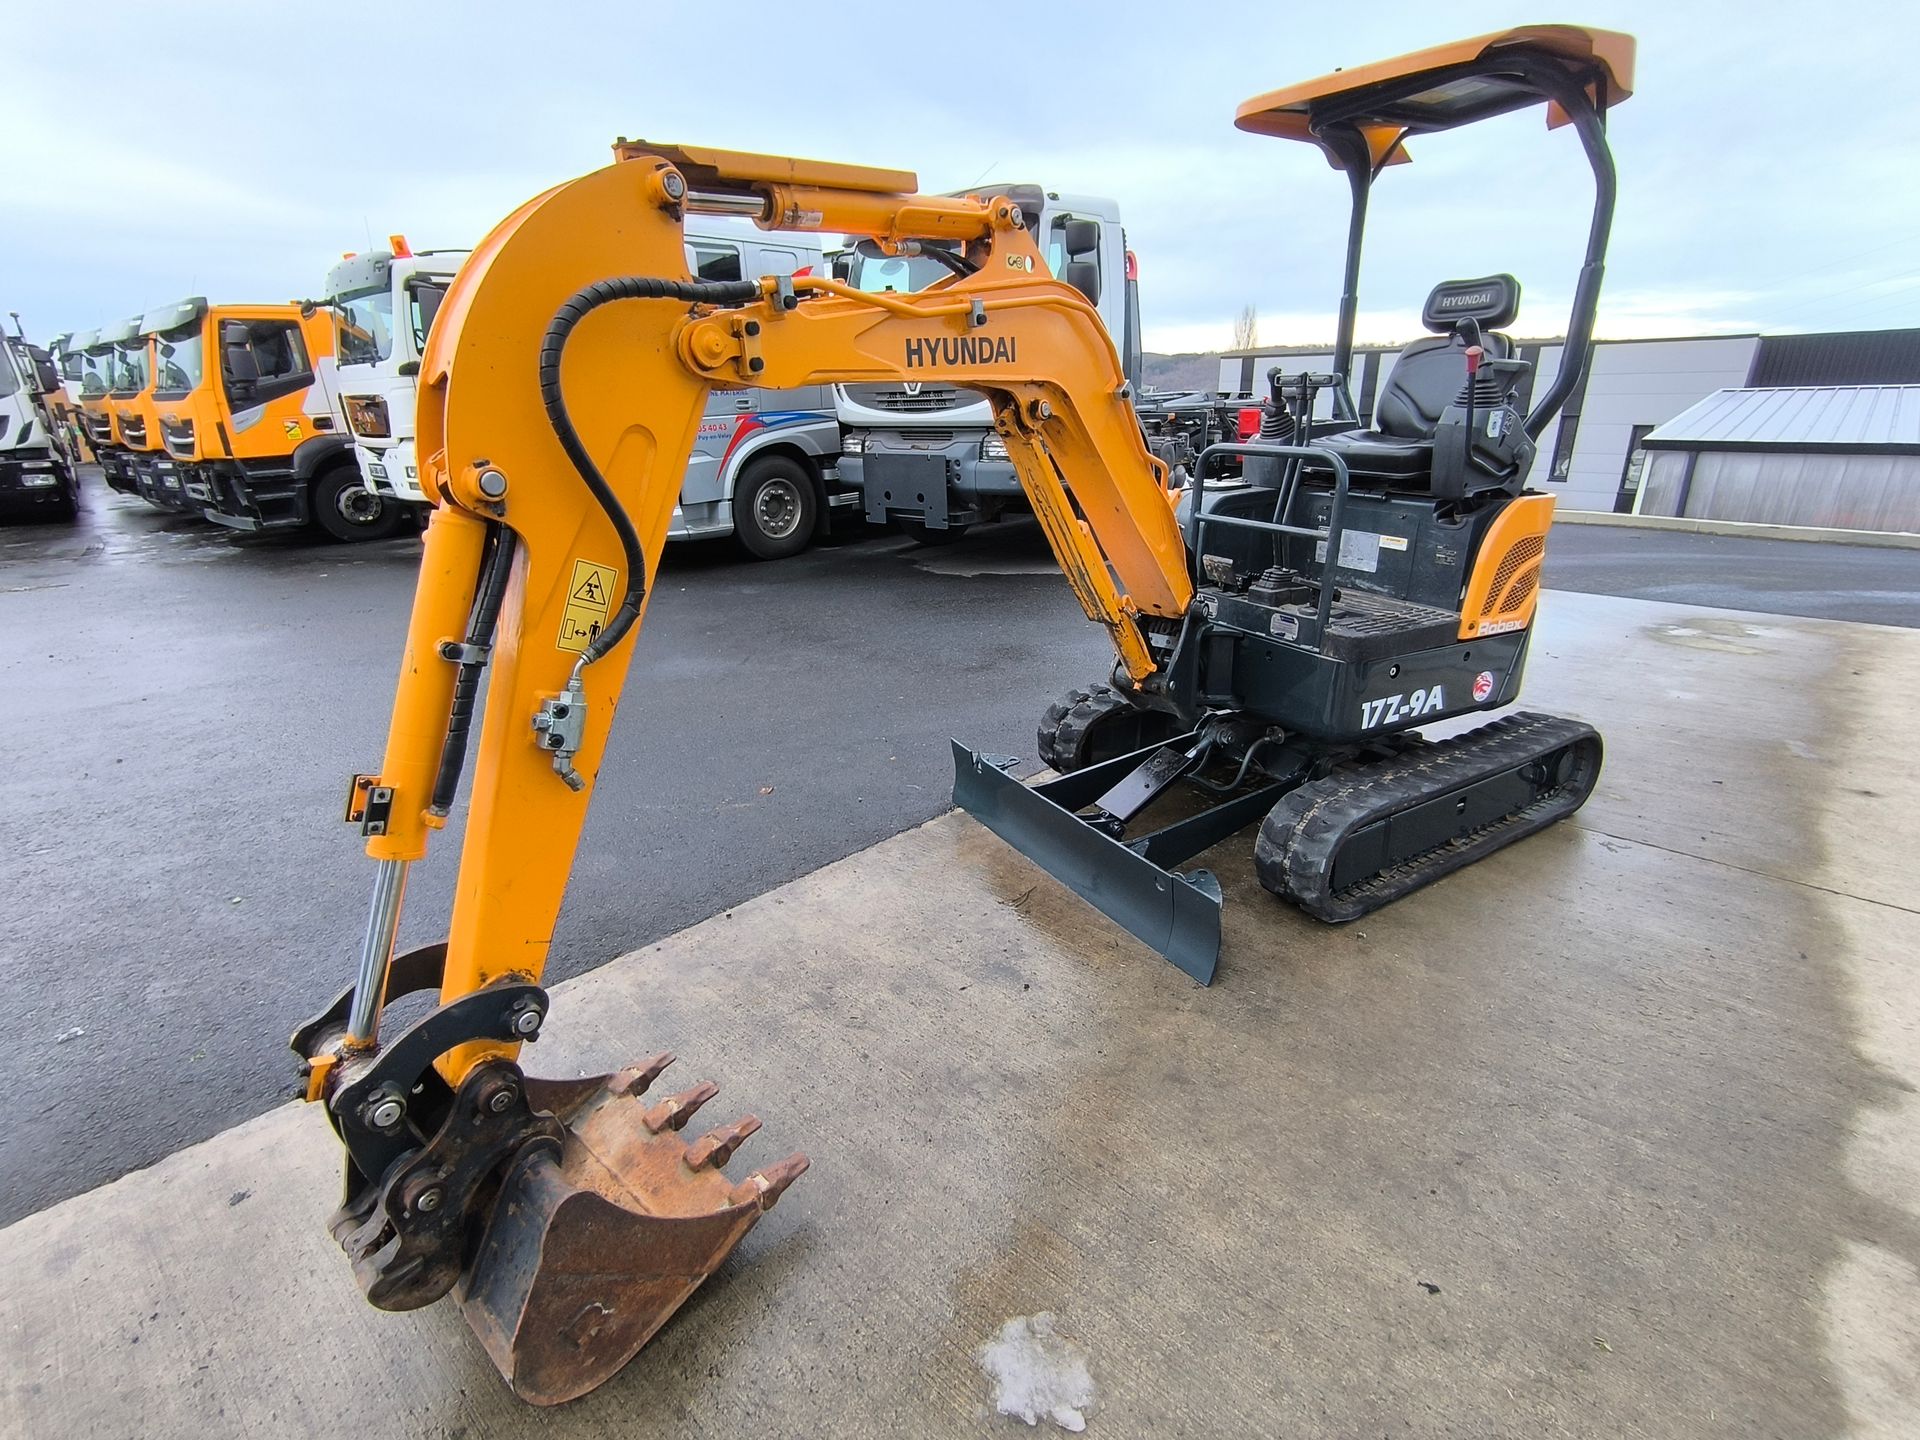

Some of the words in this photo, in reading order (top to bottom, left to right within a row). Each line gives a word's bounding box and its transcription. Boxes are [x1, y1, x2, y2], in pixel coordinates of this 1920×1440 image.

[1442, 294, 1490, 307] HYUNDAI
[905, 336, 1015, 368] HYUNDAI
[708, 424, 717, 432] 40
[718, 423, 727, 431] 43
[1479, 620, 1521, 636] Robex
[1361, 685, 1443, 730] 17Z-9A
